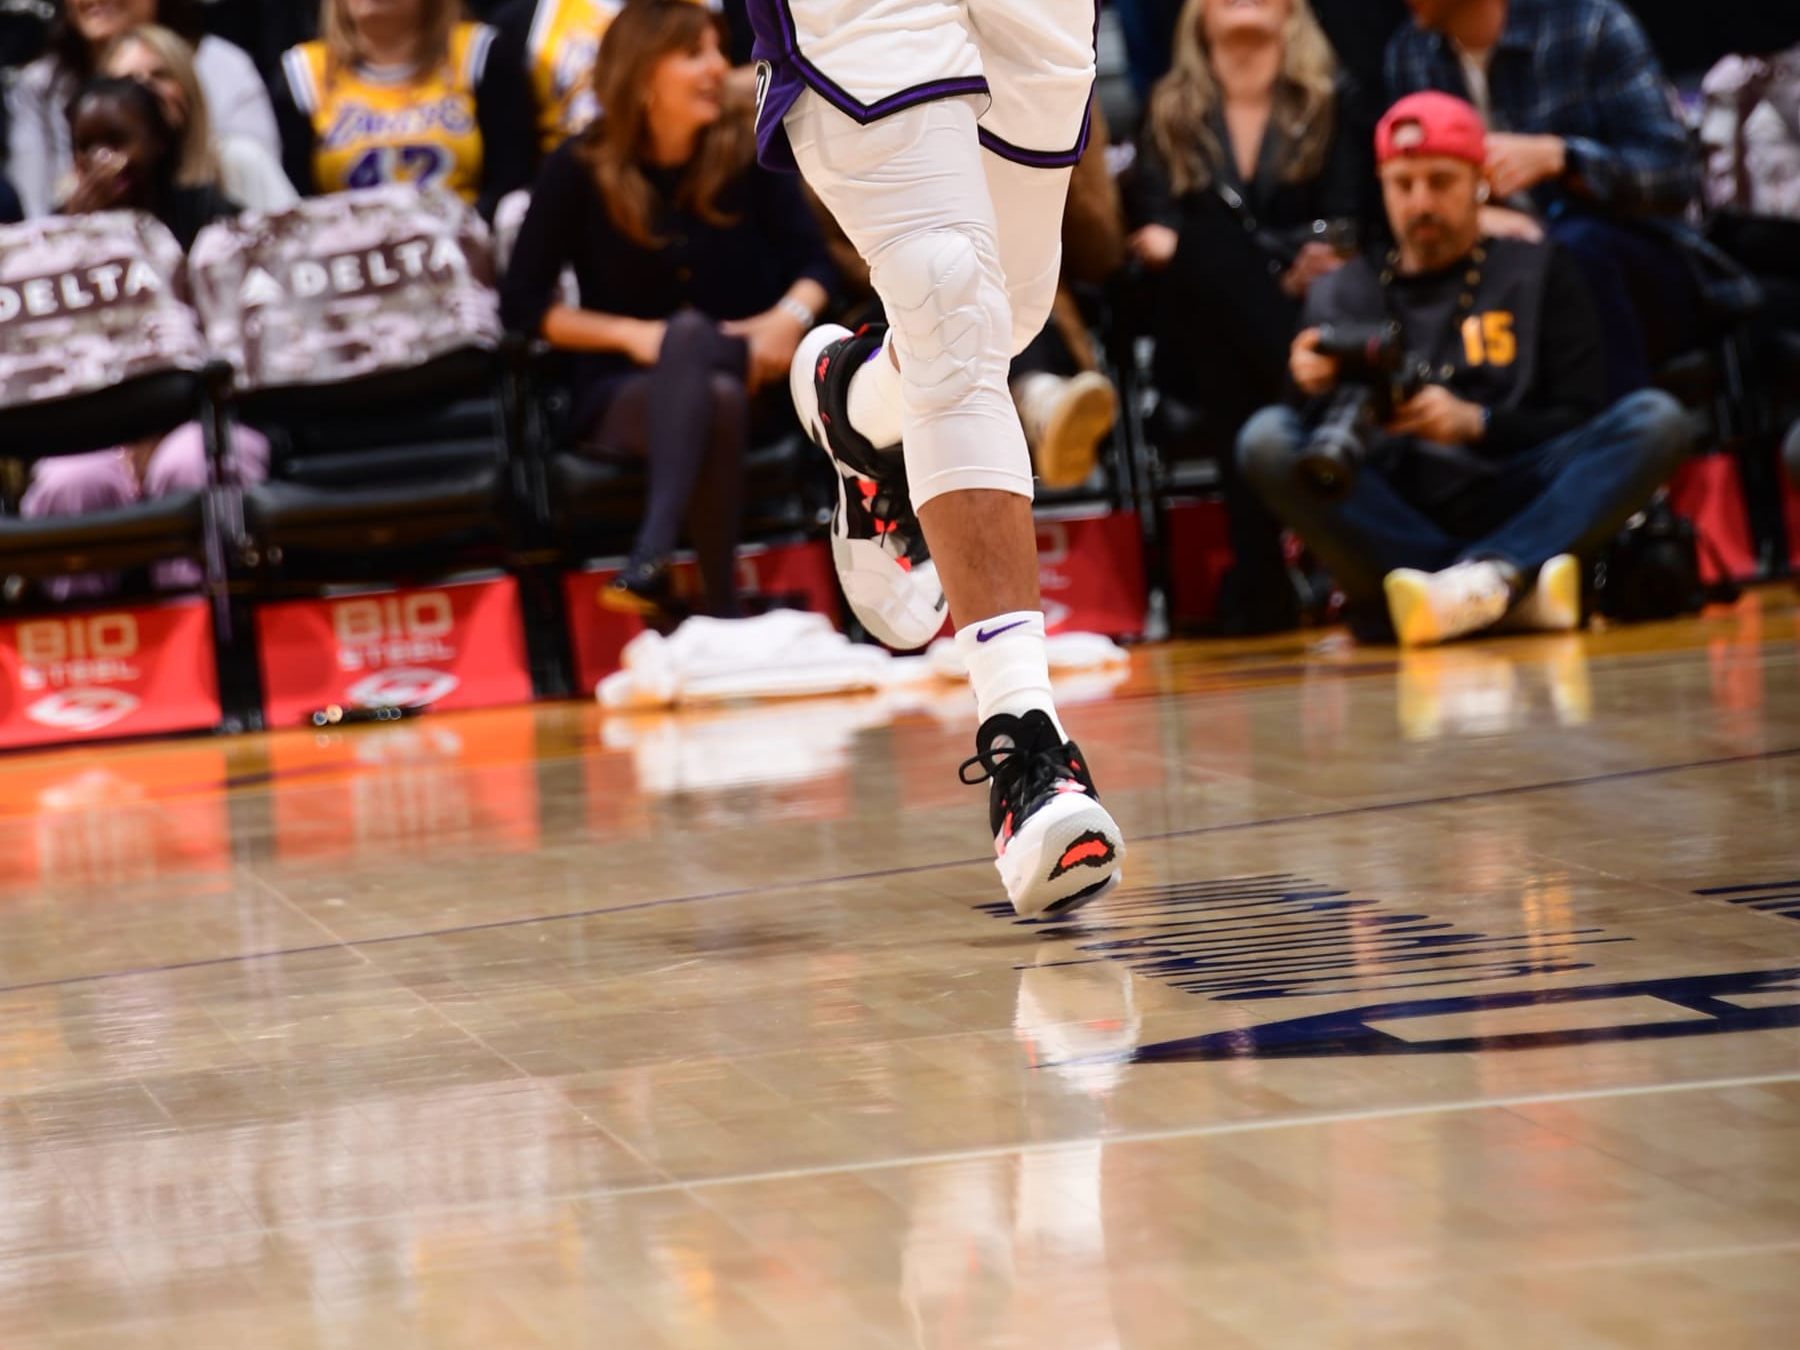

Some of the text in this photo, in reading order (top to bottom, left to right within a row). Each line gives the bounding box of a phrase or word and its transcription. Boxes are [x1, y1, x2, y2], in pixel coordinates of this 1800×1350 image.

[291, 237, 467, 299] DELTA
[1461, 310, 1517, 367] 15
[18, 612, 139, 665] BIO
[335, 592, 454, 644] BIO
